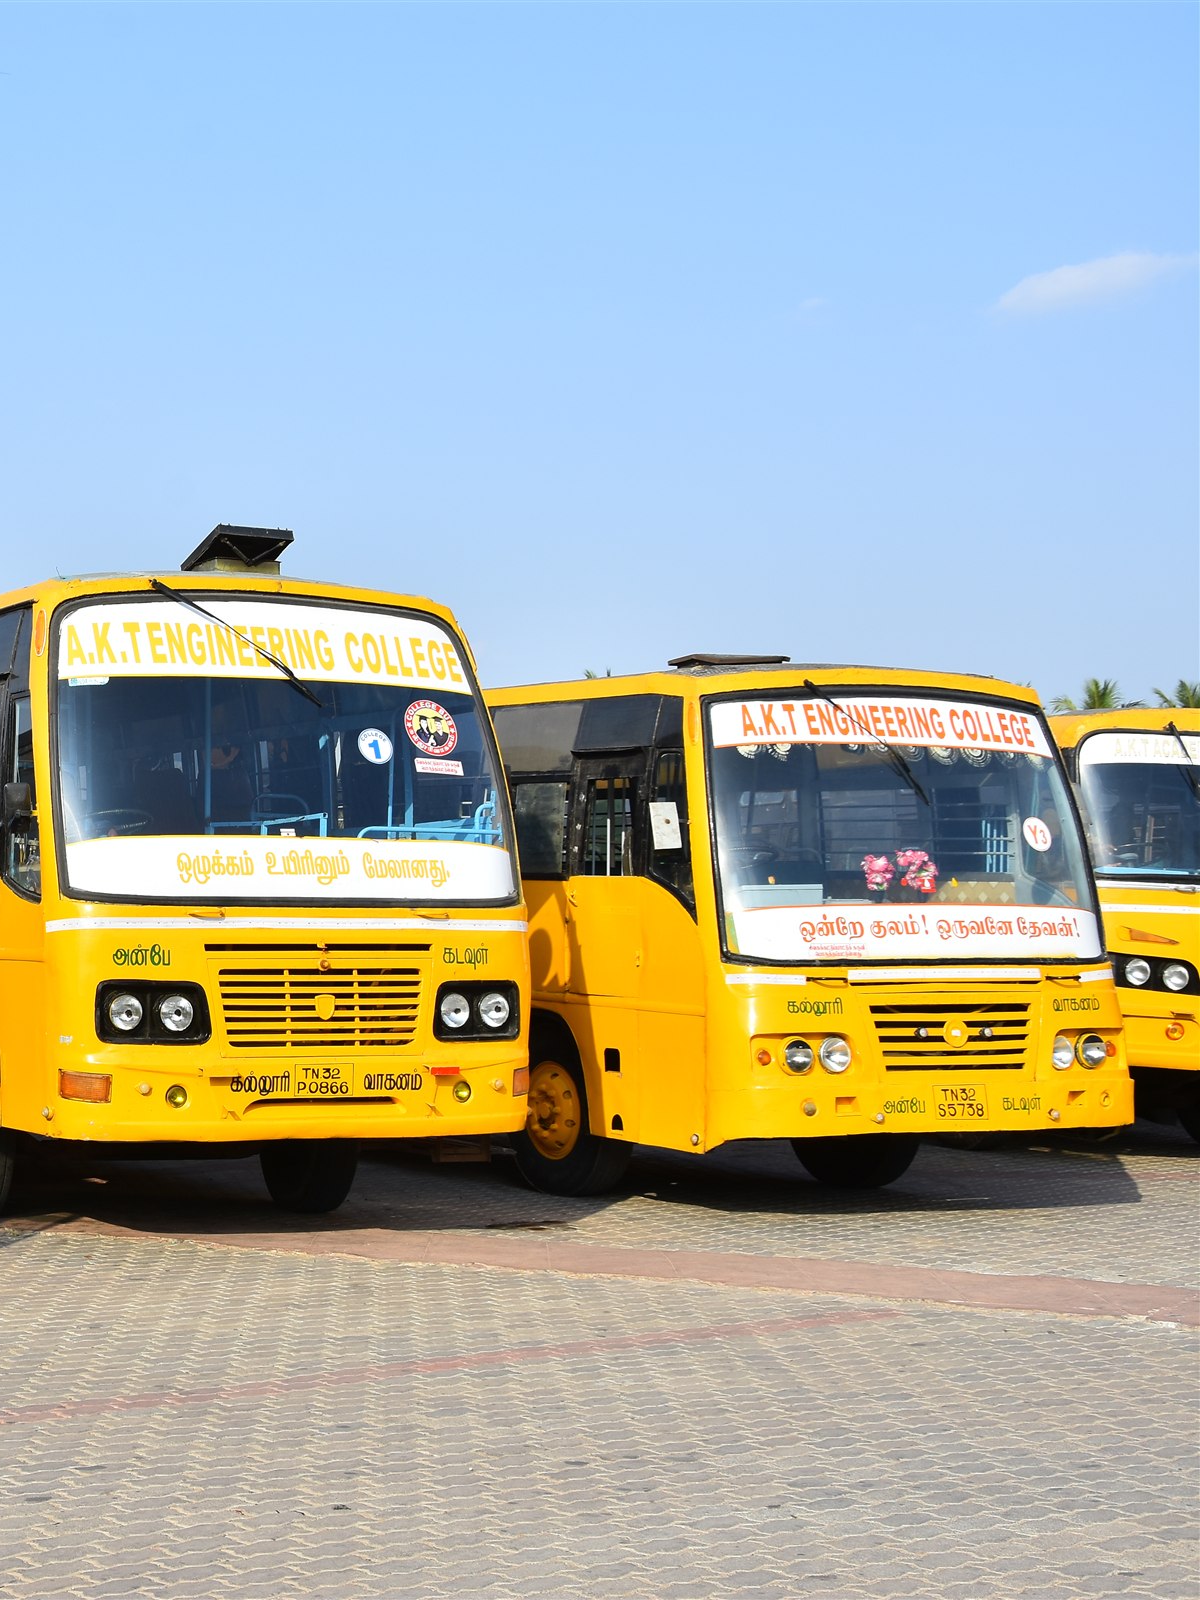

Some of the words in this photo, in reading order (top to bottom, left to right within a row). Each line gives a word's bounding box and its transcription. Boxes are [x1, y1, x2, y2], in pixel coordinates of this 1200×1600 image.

[67, 622, 149, 666] A.K.T
[149, 622, 335, 671] ENGINEERING
[345, 632, 463, 682] COLLEGE
[406, 701, 437, 720] COLLEGE
[438, 708, 454, 727] BUS
[360, 732, 387, 742] COLLEGE
[741, 704, 797, 736] A.K.T
[803, 704, 945, 739] ENGINEERING
[949, 709, 1035, 748] COLLEGE
[368, 739, 382, 759] 1
[1027, 825, 1047, 844] Y3
[177, 849, 254, 884] ஒழுக்கம்
[265, 849, 350, 885] உயிரினும்
[799, 916, 864, 942] ஒன்றே
[936, 917, 1014, 941] ஒருவனே
[112, 943, 171, 967] அன்பே
[442, 942, 489, 970] கடவுள்
[787, 997, 843, 1017] கல்லூரி
[1052, 994, 1100, 1012] வாகனம்
[230, 1070, 290, 1096] கல்லூரி
[363, 1068, 423, 1091] வாகனம்
[302, 1068, 341, 1079] TN.32
[297, 1081, 349, 1095] P.0866
[883, 1096, 926, 1114] அன்பே
[1003, 1093, 1041, 1115] கடவுள்
[938, 1103, 985, 1118] S5738
